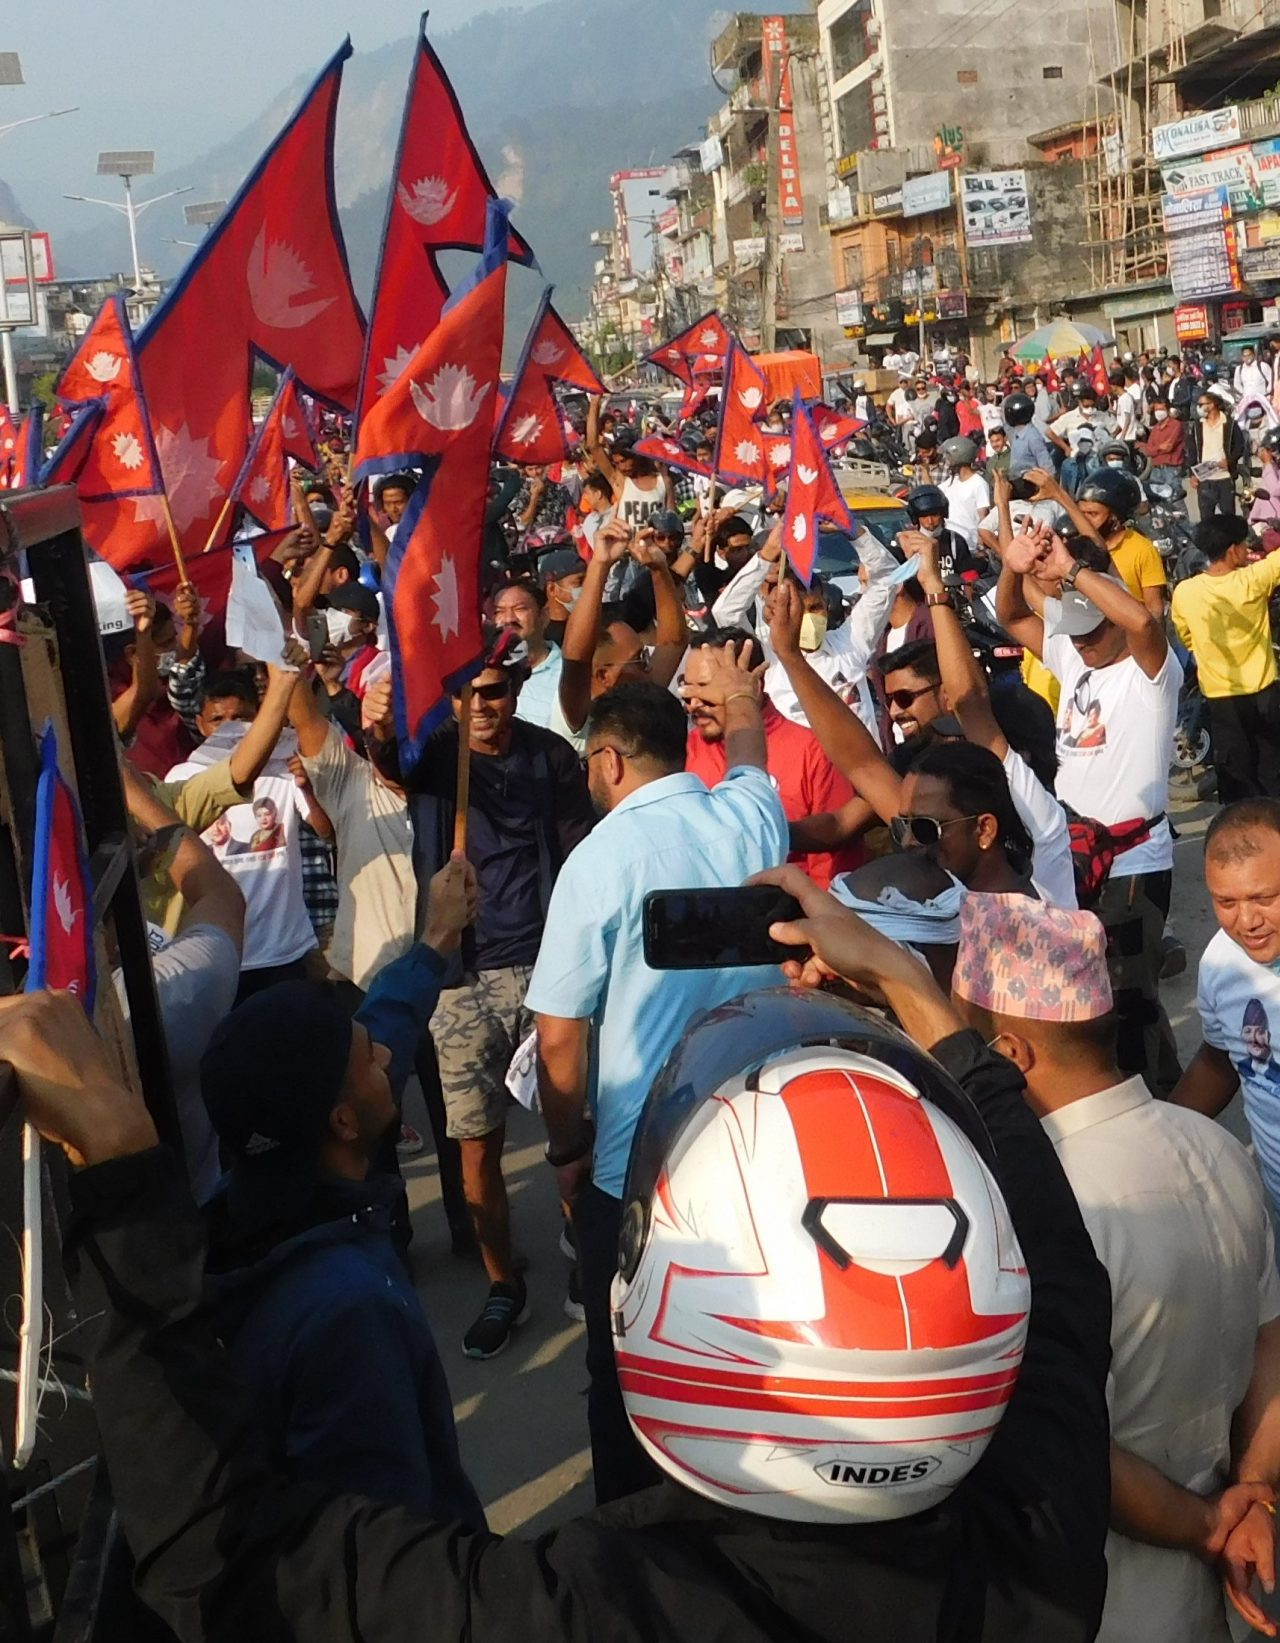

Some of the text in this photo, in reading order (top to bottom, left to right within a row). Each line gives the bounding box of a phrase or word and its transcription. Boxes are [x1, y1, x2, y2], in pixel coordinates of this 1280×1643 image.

[1188, 166, 1243, 188] FAST TRACK
[830, 1462, 929, 1484] INDES
